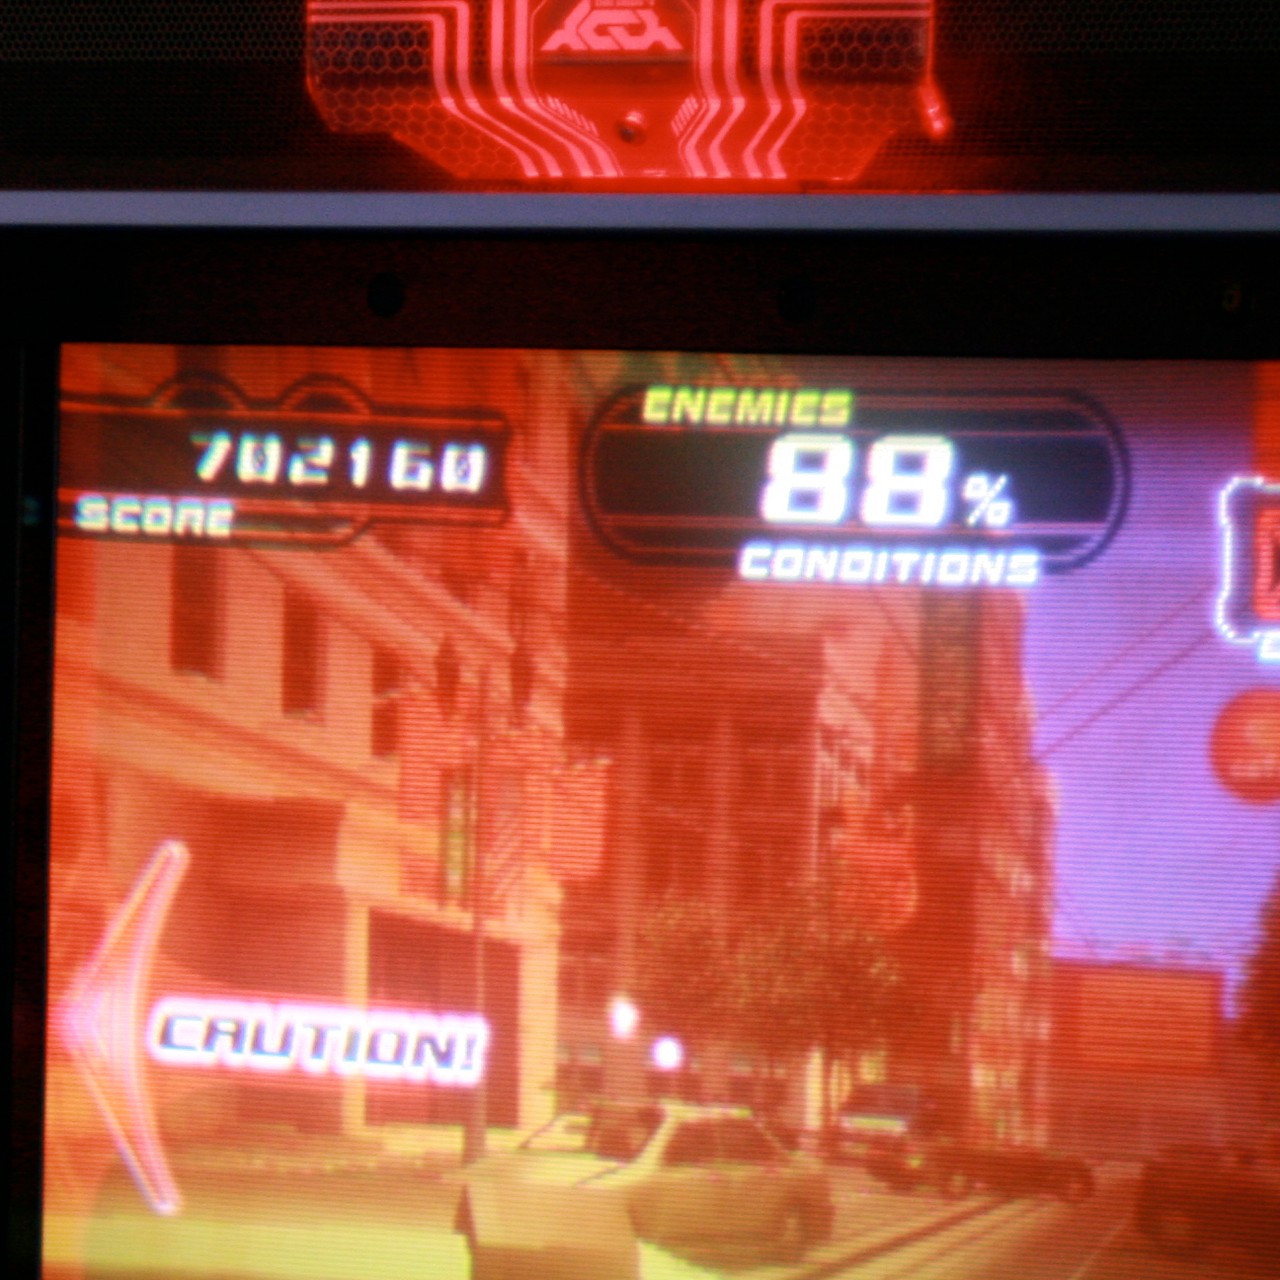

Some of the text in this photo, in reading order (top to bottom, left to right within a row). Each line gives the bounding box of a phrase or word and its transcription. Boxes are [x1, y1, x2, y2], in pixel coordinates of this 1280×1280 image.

[641, 383, 853, 427] ENEMIES
[191, 429, 487, 493] 702160
[74, 494, 236, 538] SCORE
[738, 541, 1042, 585] CONDITIONS
[153, 1007, 483, 1077] CAUTION!
